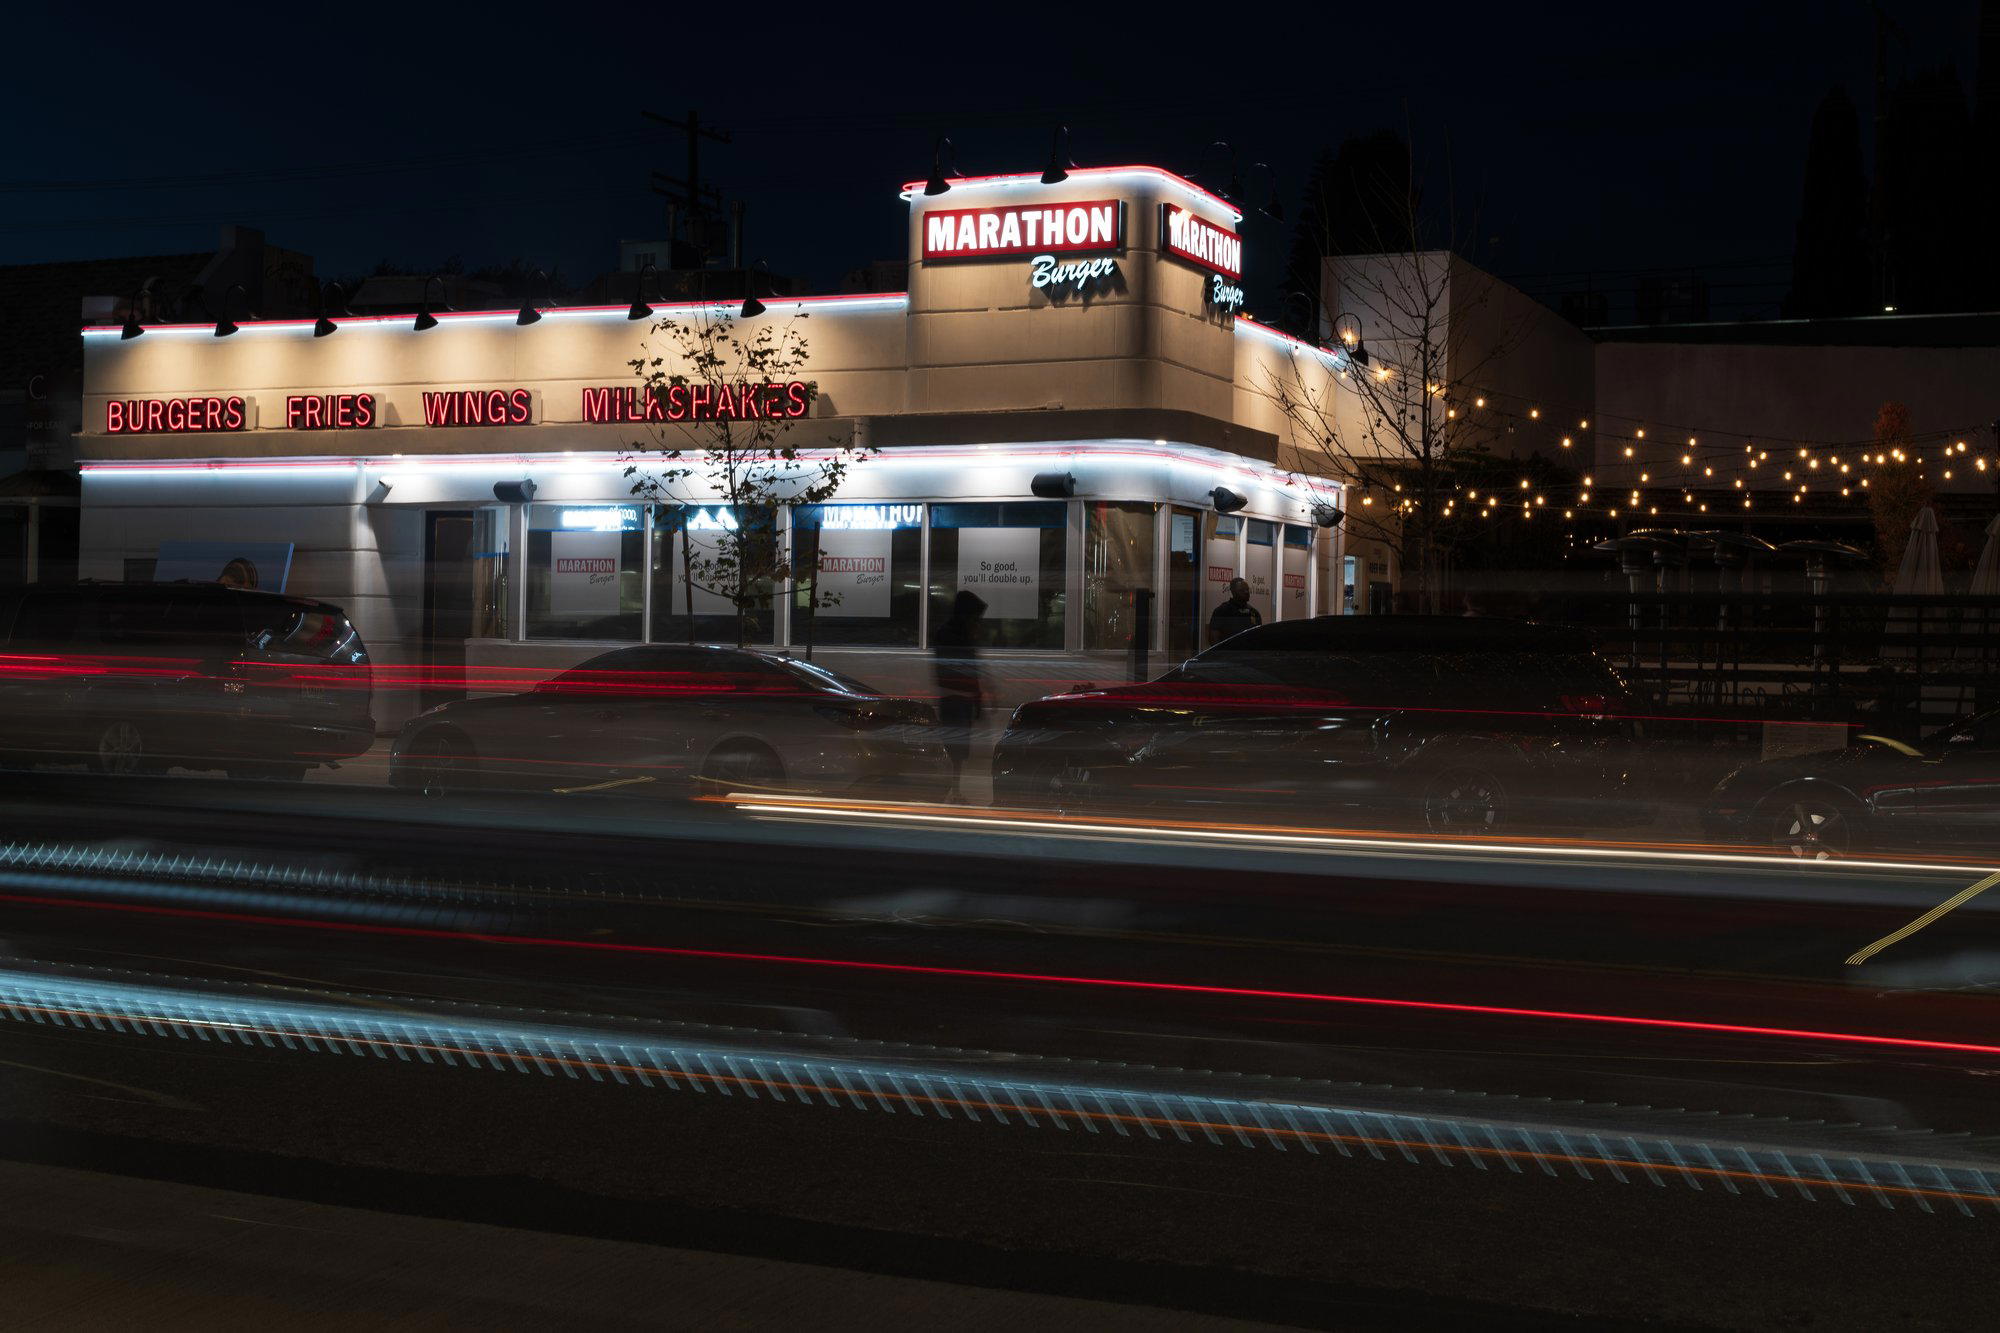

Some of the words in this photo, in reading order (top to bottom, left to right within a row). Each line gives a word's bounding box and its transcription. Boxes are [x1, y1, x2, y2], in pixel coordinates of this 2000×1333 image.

[928, 207, 1112, 252] MARATHON
[1169, 209, 1242, 274] MARATHON
[1031, 255, 1115, 289] Burger
[1212, 275, 1244, 312] Burger
[107, 396, 244, 432] BURGERS
[287, 393, 374, 430] FRIES
[423, 389, 530, 426] WINGS
[582, 381, 809, 423] MILKSHAKES
[559, 560, 614, 572] MARATHON
[589, 573, 615, 586] Burger
[823, 559, 883, 571] MARATHON
[856, 573, 884, 586] Burger
[963, 573, 986, 584] you'll
[988, 573, 1018, 583] double
[1019, 576, 1033, 585] up.
[980, 561, 992, 571] So
[994, 561, 1018, 573] good,
